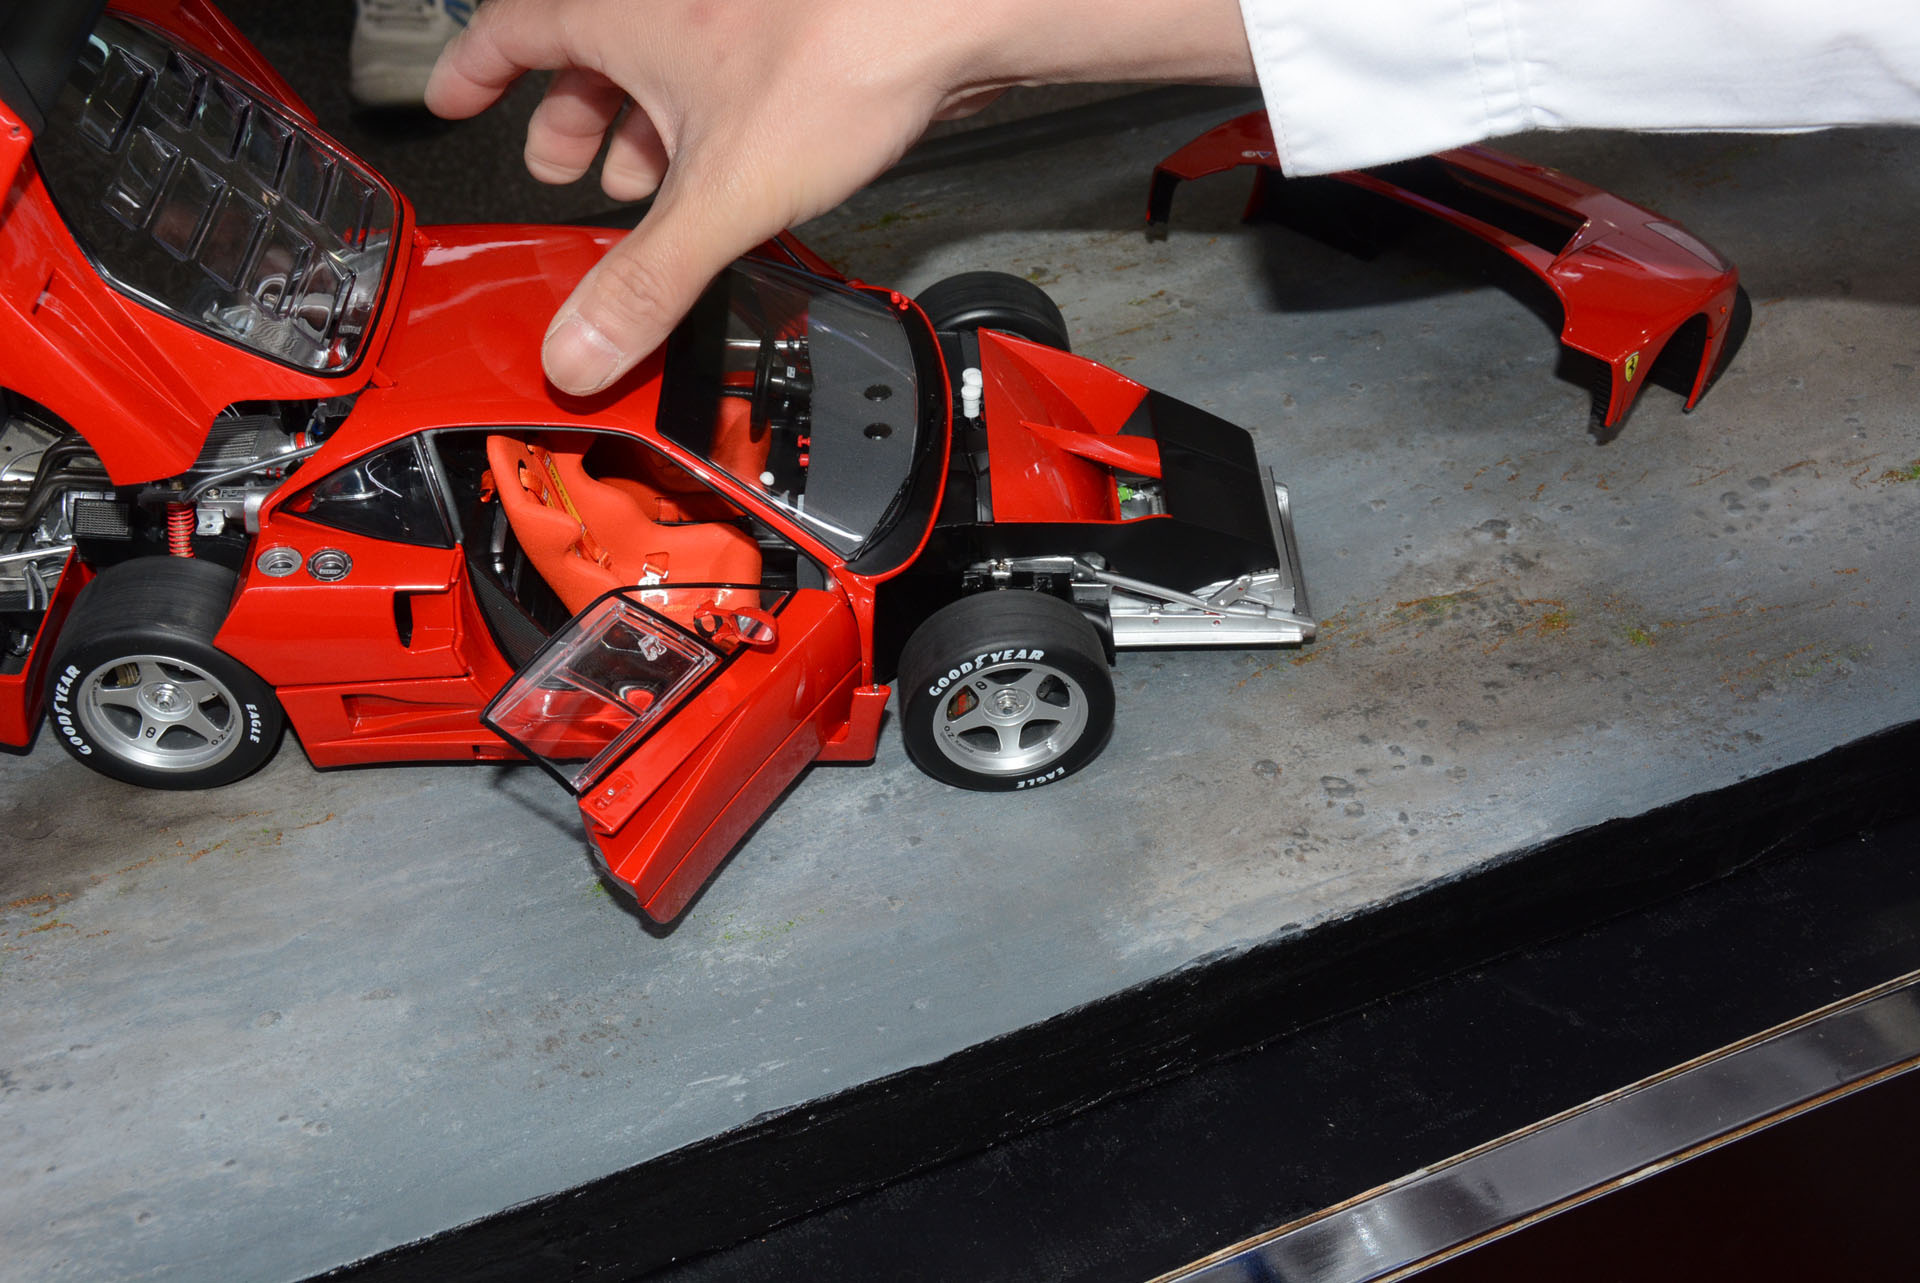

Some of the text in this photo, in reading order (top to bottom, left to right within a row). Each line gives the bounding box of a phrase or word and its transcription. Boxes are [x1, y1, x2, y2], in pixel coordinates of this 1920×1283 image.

[928, 649, 1045, 697] GOODYEAR
[52, 665, 92, 755] GOODYEAR
[245, 703, 262, 744] EAGLE
[1016, 766, 1066, 789] EAGLE
